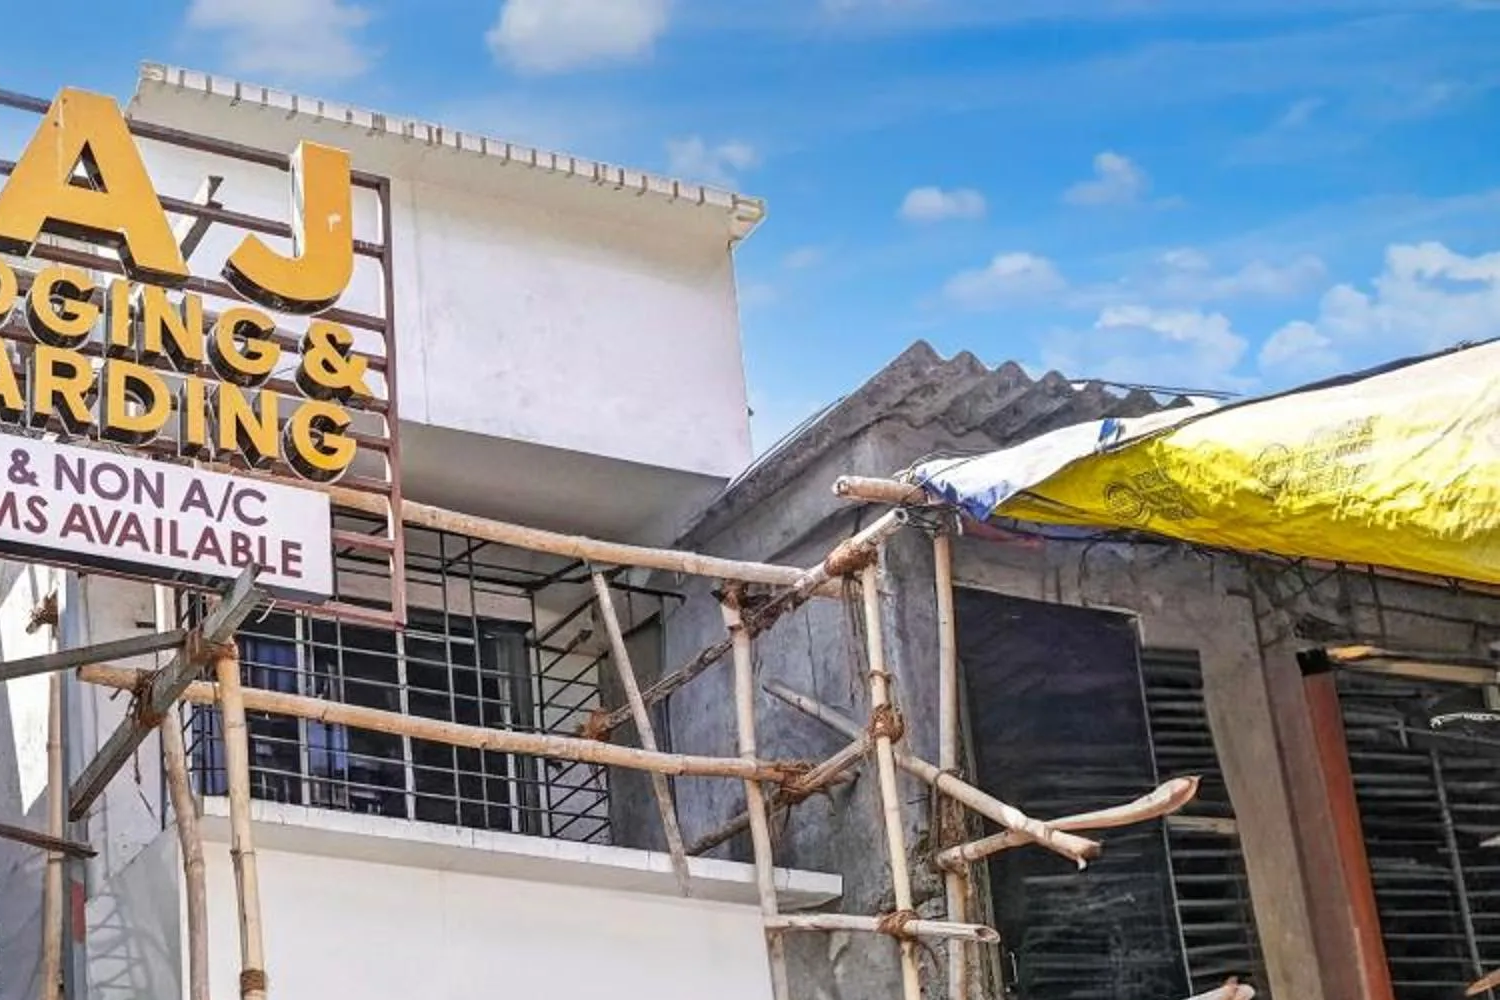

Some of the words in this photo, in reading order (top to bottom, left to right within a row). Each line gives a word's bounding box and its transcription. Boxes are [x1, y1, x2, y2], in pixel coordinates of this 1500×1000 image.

[7, 447, 41, 488] &
[54, 453, 166, 510] NON
[179, 477, 269, 528] A/C
[59, 502, 304, 579] AVAILABLE
